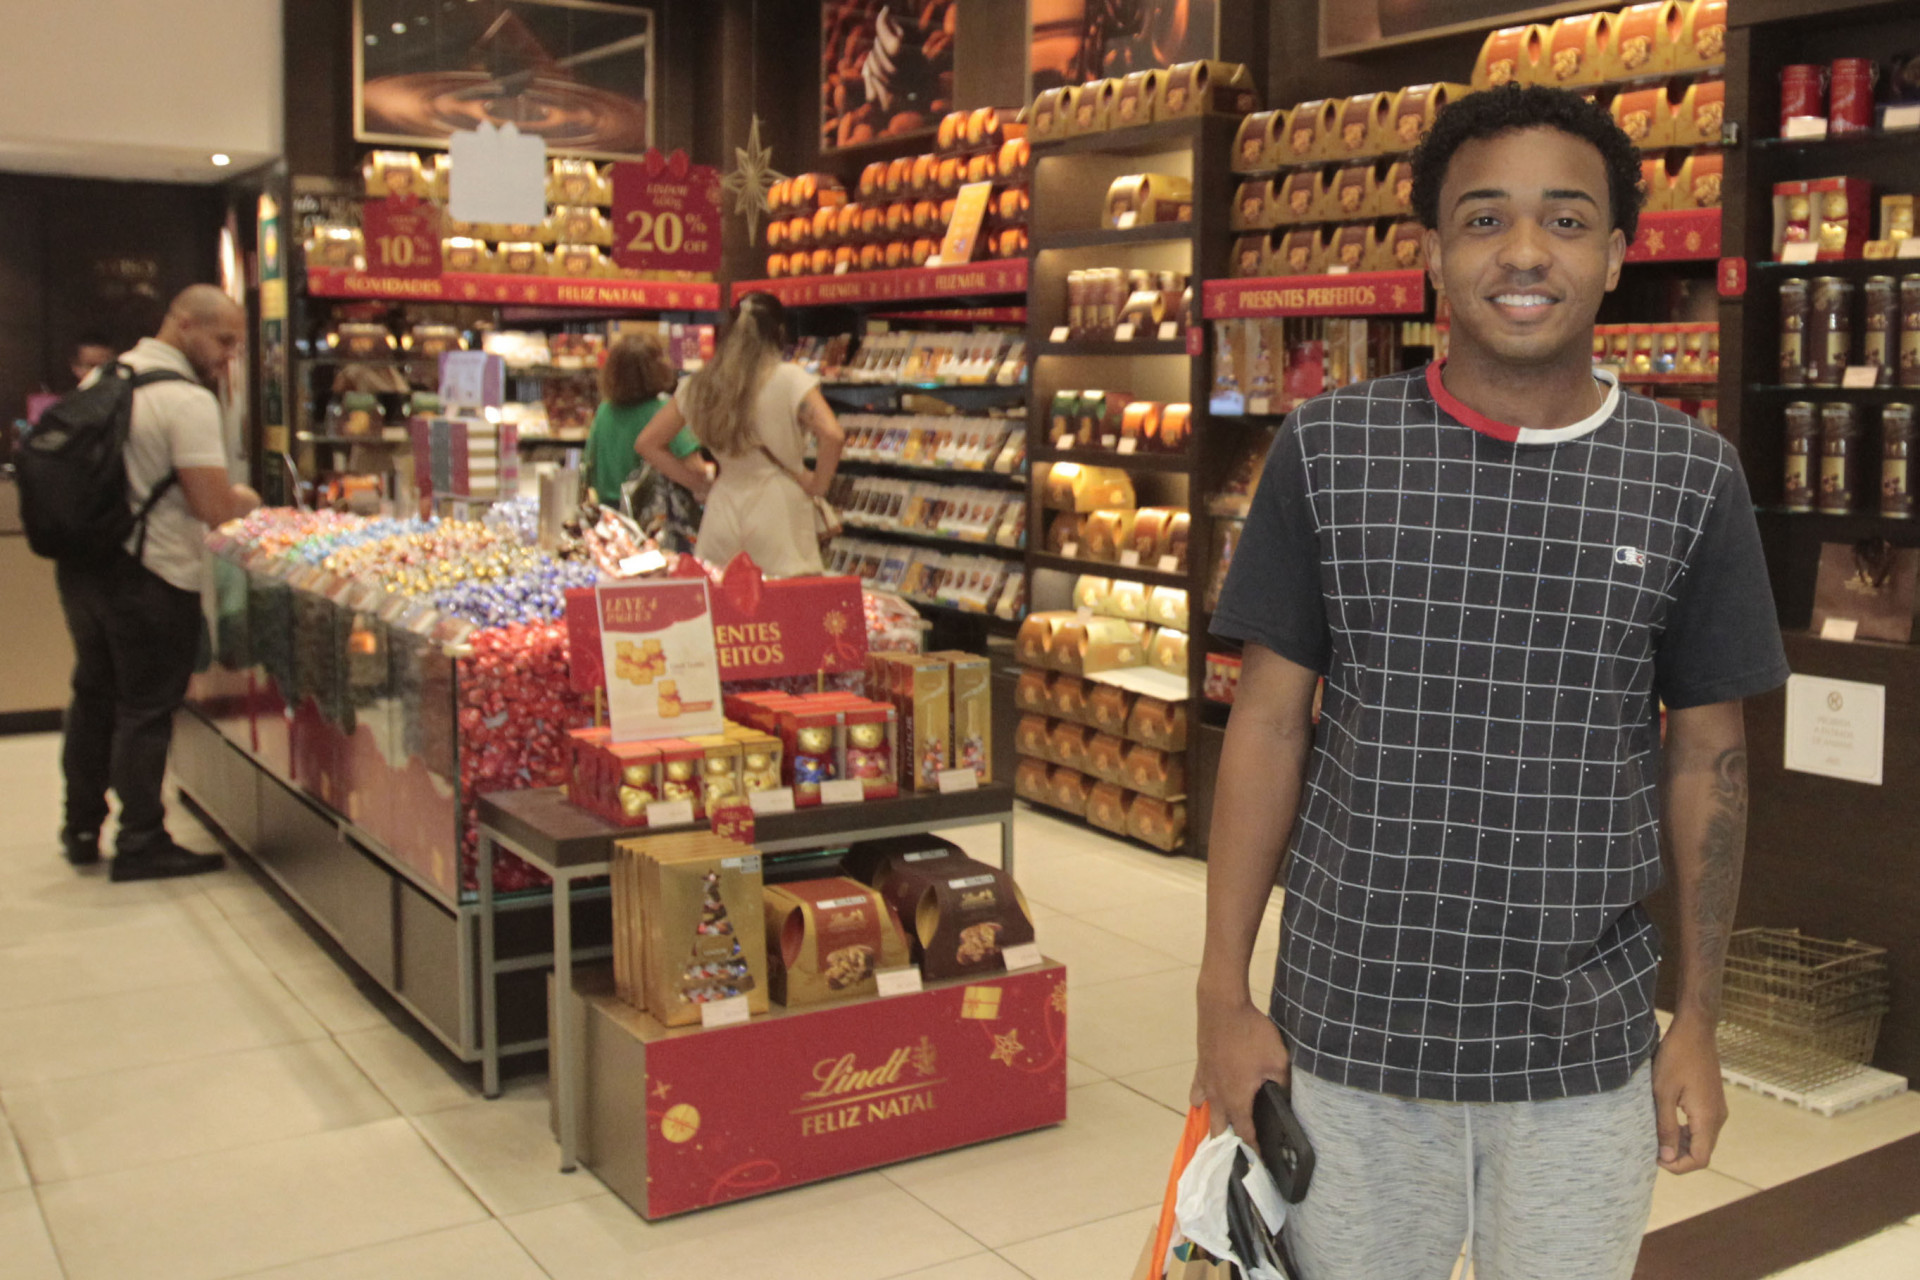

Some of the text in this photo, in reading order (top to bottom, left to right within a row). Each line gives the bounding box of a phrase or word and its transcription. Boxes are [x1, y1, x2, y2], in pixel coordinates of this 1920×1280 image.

[344, 277, 443, 295] NOVIDADES
[557, 285, 646, 303] FELIZ NATAL
[1239, 285, 1376, 309] PRESENTES PERFEITOS
[715, 622, 782, 645] ENTES
[717, 644, 785, 668] EITOS
[802, 1046, 912, 1100] Lindt
[802, 1091, 936, 1137] FELIZ NATAL
